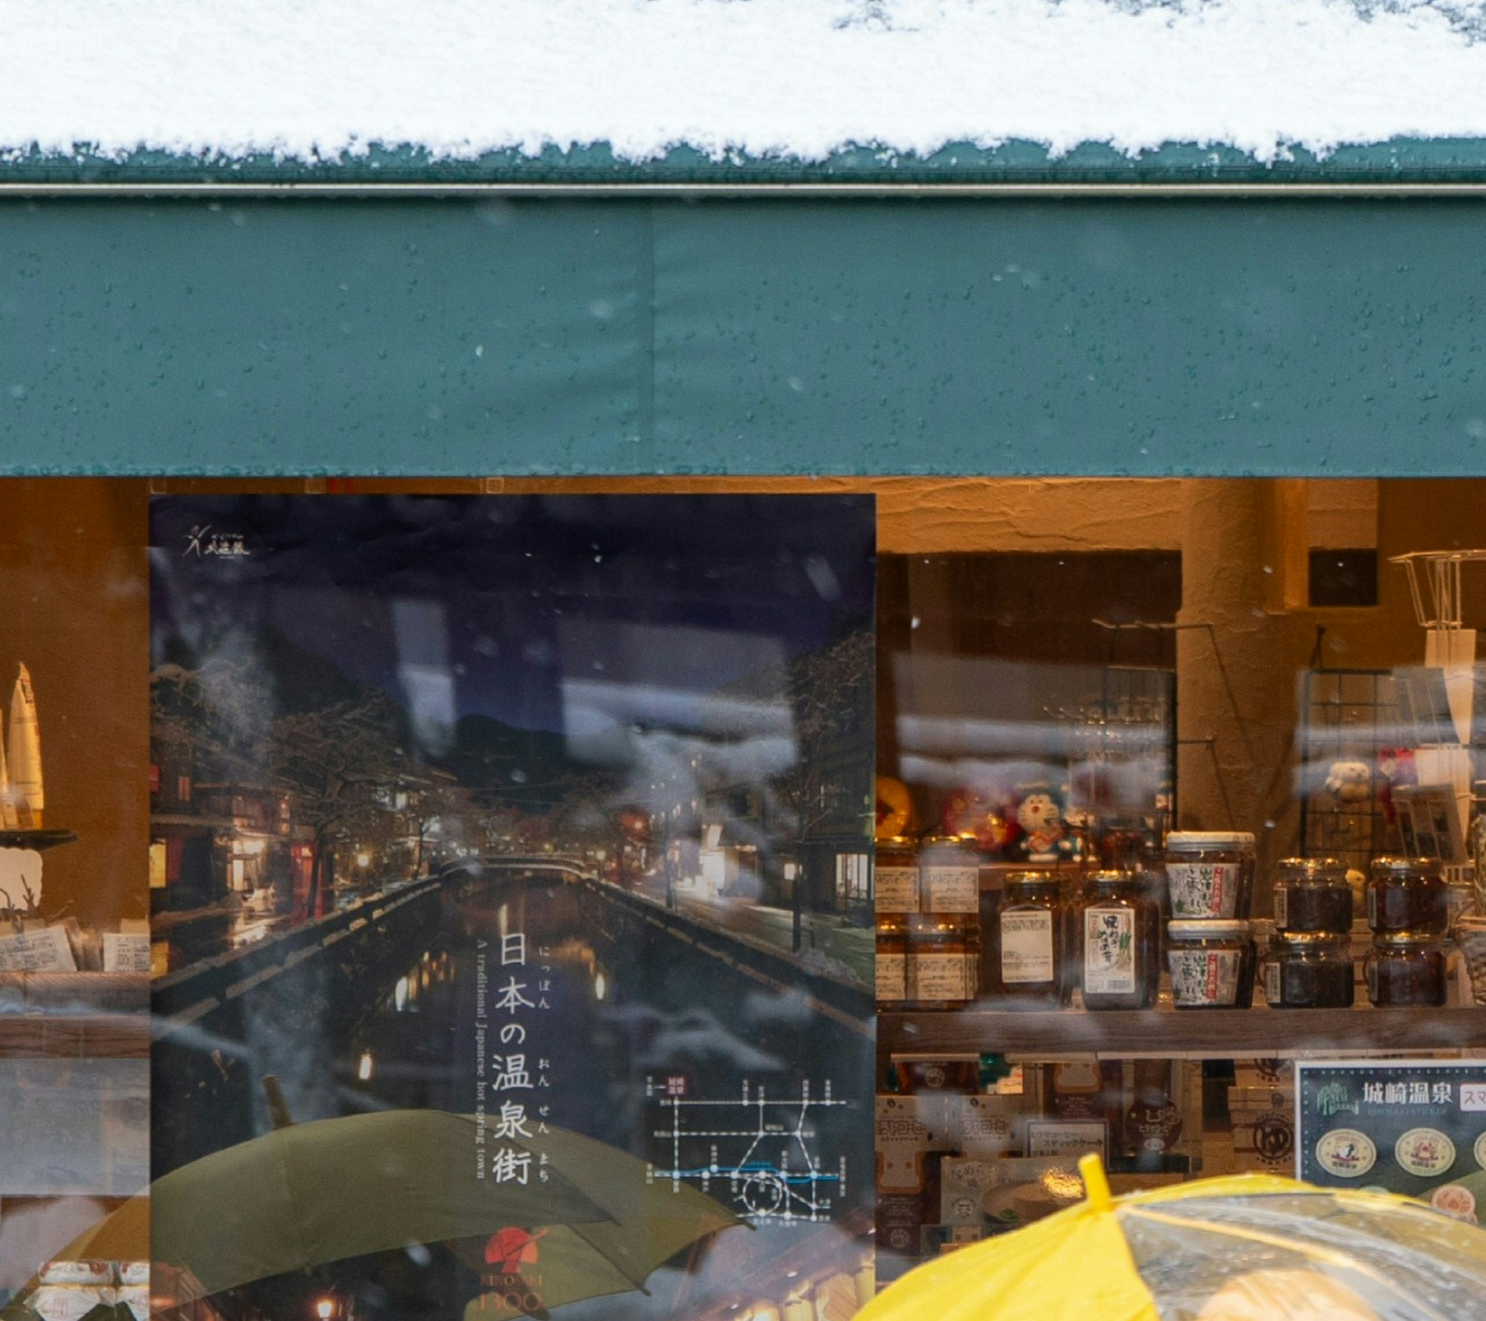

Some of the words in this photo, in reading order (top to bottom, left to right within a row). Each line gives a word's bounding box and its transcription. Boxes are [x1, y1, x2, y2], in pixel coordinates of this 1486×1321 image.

[476, 953, 488, 1019] traditional
[474, 1021, 488, 1078] Japanese
[491, 933, 536, 1186] 日本の温泉街
[476, 1081, 488, 1101] hot
[1361, 1081, 1454, 1106] 城崎温泉
[474, 1104, 488, 1145] spring
[476, 1148, 488, 1179] town
